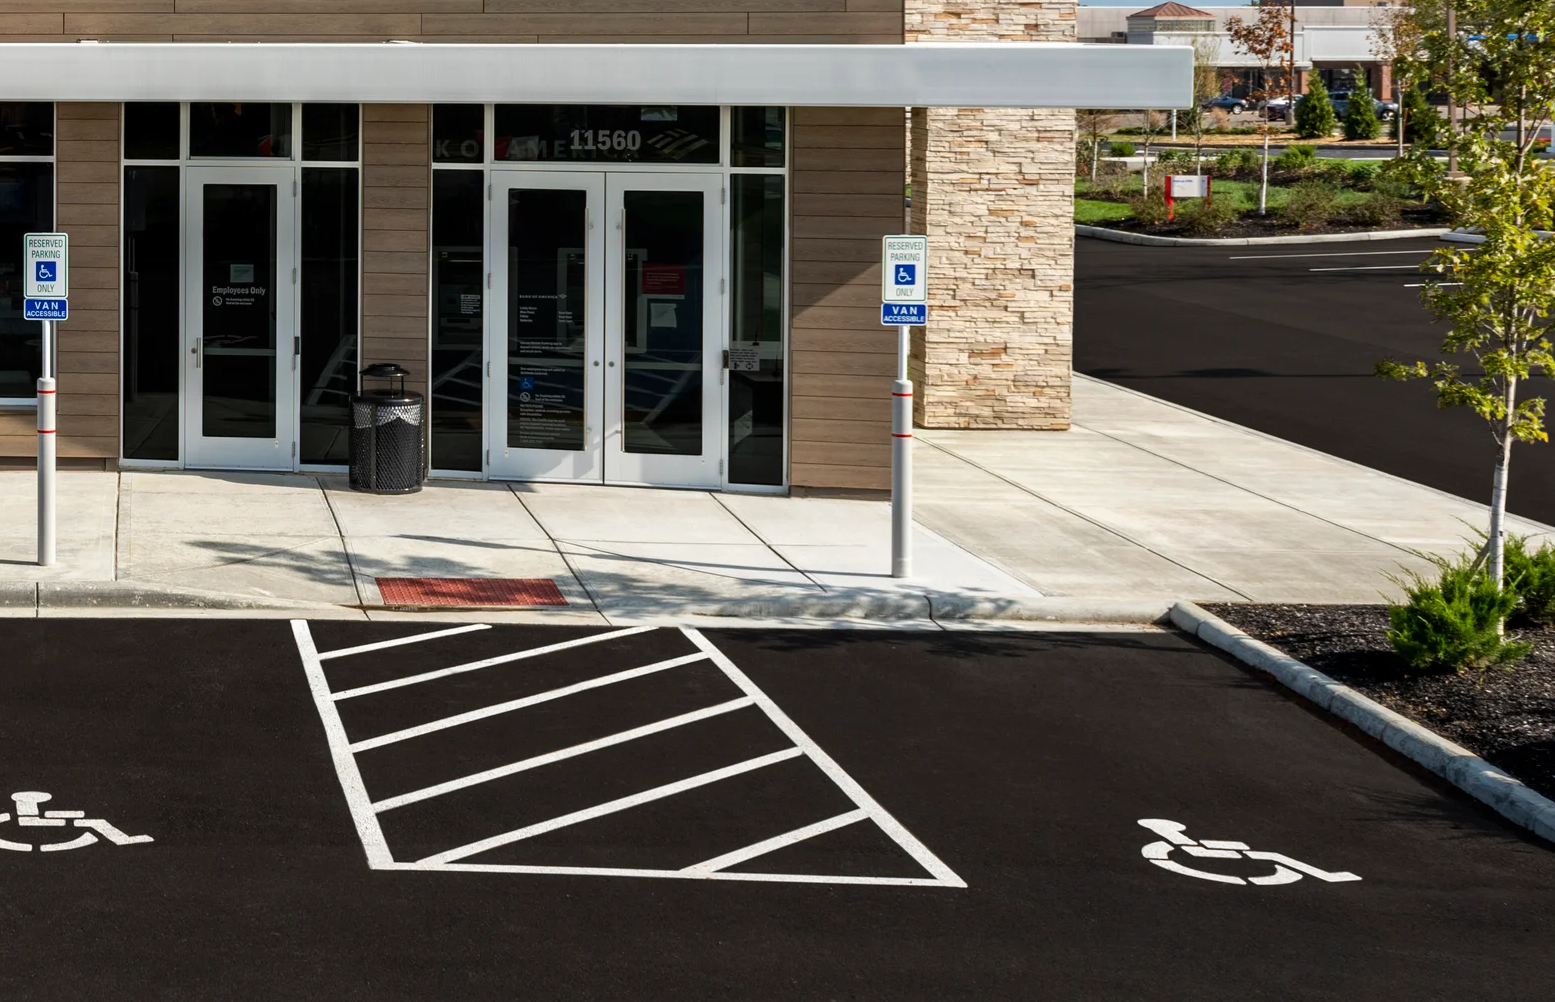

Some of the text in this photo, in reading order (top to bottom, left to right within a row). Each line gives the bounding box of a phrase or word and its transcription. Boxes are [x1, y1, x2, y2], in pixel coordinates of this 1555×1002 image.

[570, 129, 641, 151] 11560
[28, 239, 64, 248] RESERVED
[887, 241, 923, 251] RESERVED
[31, 250, 61, 259] PARKING
[890, 253, 921, 262] PARKING
[37, 284, 55, 293] ONLY
[212, 286, 266, 296] Employees Only
[895, 287, 914, 297] ONLY
[34, 301, 59, 310] VAN
[891, 306, 918, 315] VAN
[883, 315, 925, 323] ACCESSIBLE
